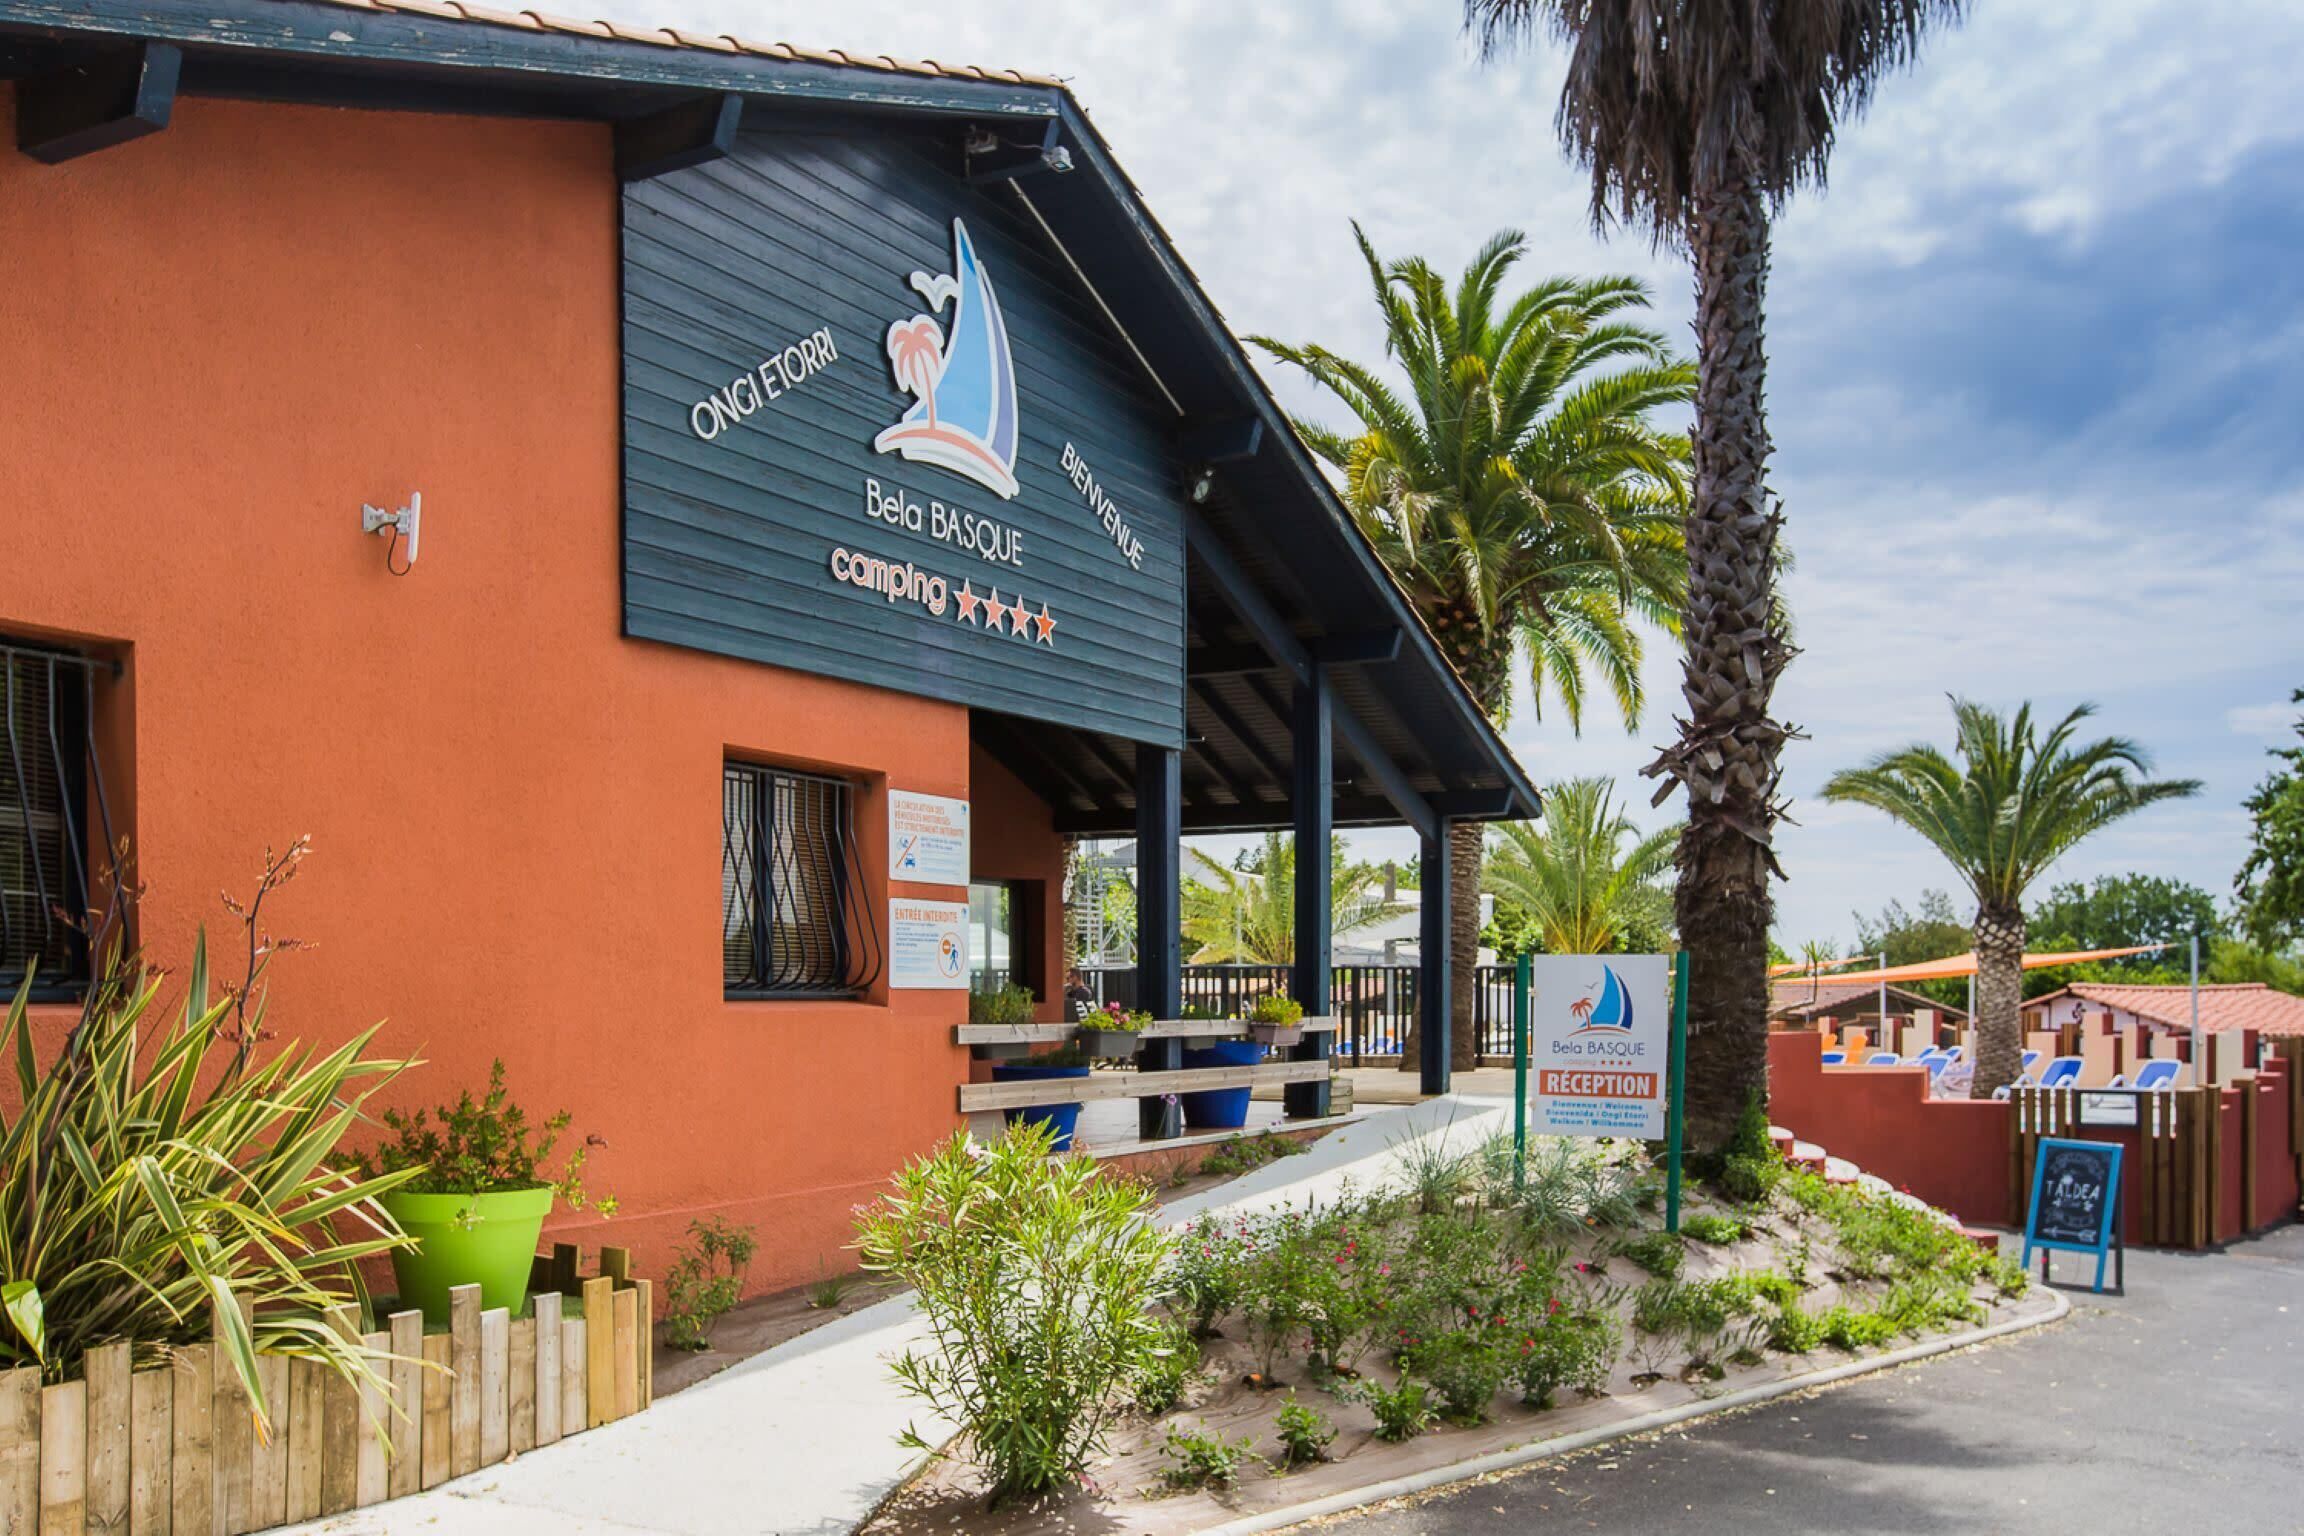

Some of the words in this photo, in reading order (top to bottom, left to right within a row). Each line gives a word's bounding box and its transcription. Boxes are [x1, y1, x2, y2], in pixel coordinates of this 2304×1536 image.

[691, 371, 764, 440] ONGI
[757, 326, 839, 401] ETORRI
[865, 478, 922, 532] Bela
[930, 501, 1023, 567] BASQUE
[1060, 441, 1144, 570] BIENVENUE
[831, 547, 946, 616] camping
[895, 907, 921, 921] ENTRÉE
[923, 910, 958, 923] INTERDITE
[1552, 1040, 1582, 1055] Bela
[1587, 1041, 1645, 1056] BASQUE
[1547, 1071, 1650, 1096] RÉCEPTION
[2046, 1180, 2101, 1200] TALDEA
